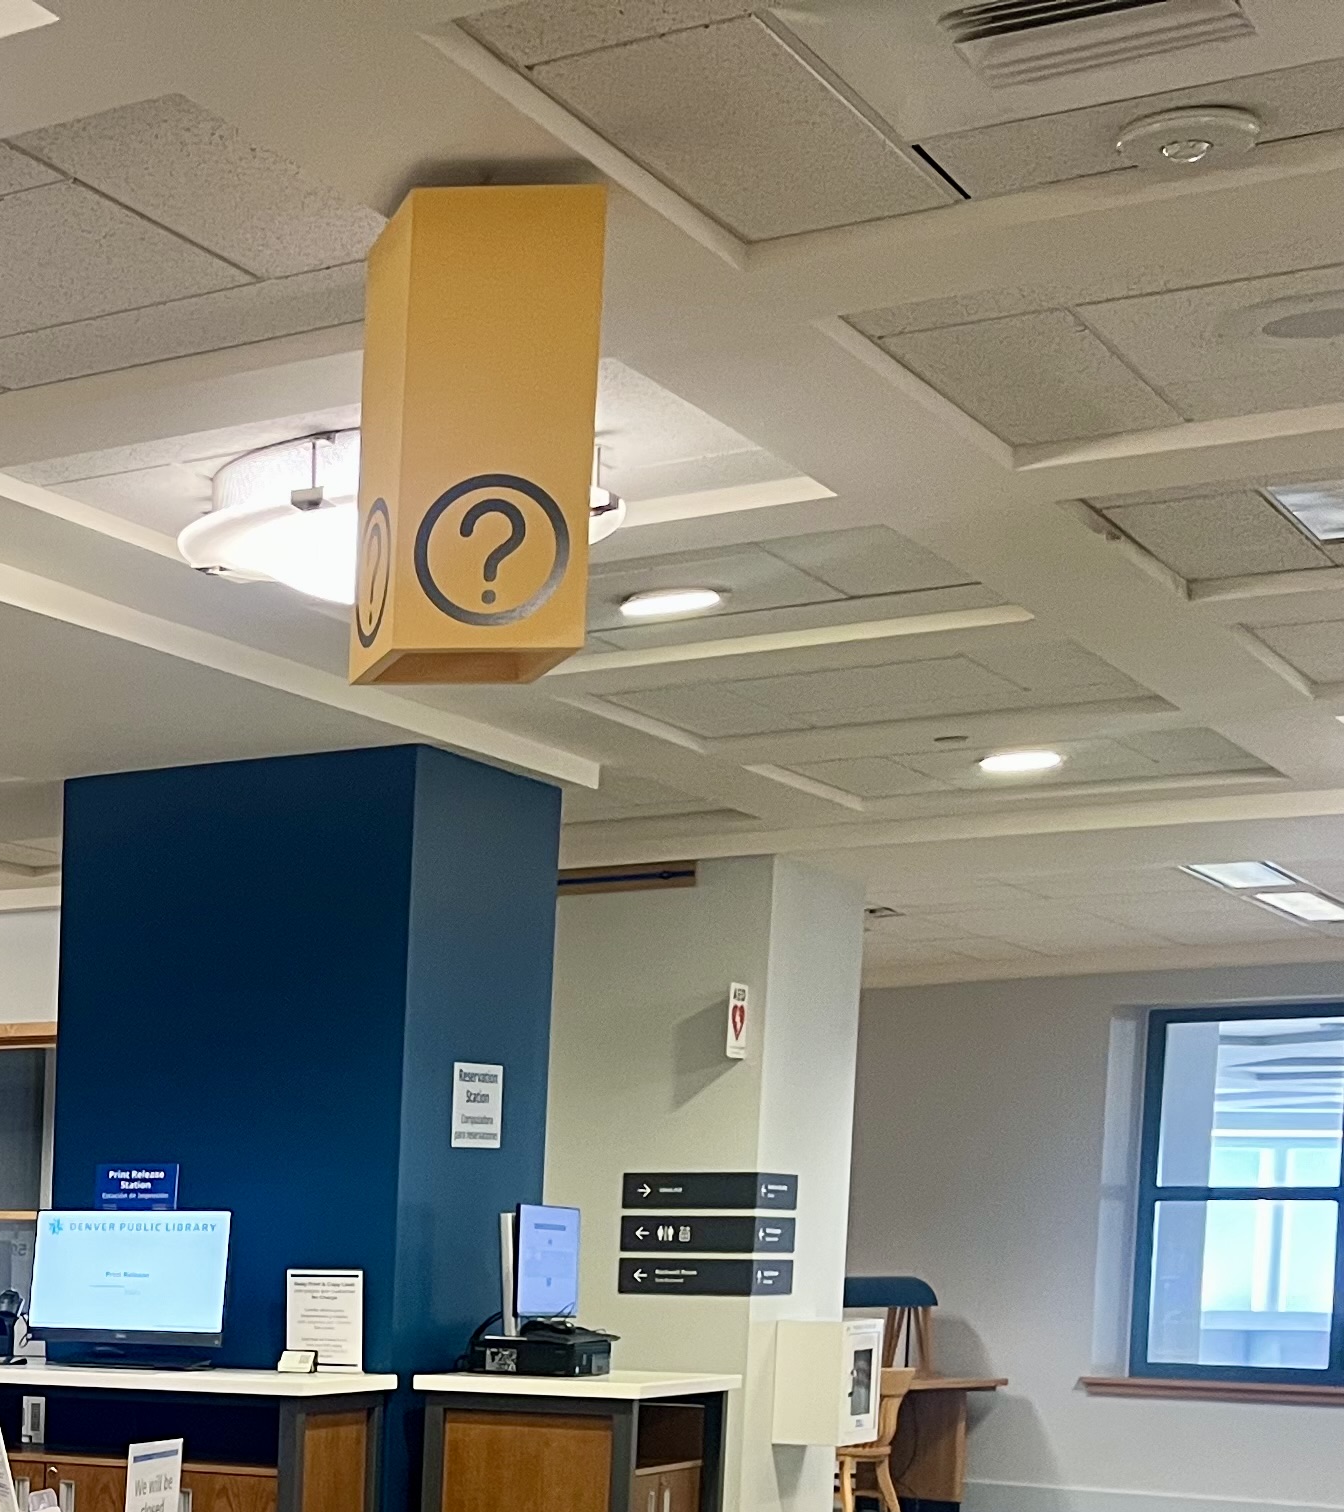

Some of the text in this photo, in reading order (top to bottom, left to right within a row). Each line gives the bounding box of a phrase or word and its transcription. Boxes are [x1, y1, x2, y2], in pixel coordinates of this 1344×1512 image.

[459, 1068, 498, 1084] Reservation
[466, 1089, 490, 1104] Station
[109, 1170, 165, 1179] Print Release
[120, 1181, 152, 1190] Station
[70, 1222, 217, 1232] DENVER PUBLIC LIBRARY
[135, 1473, 174, 1497] We will be
